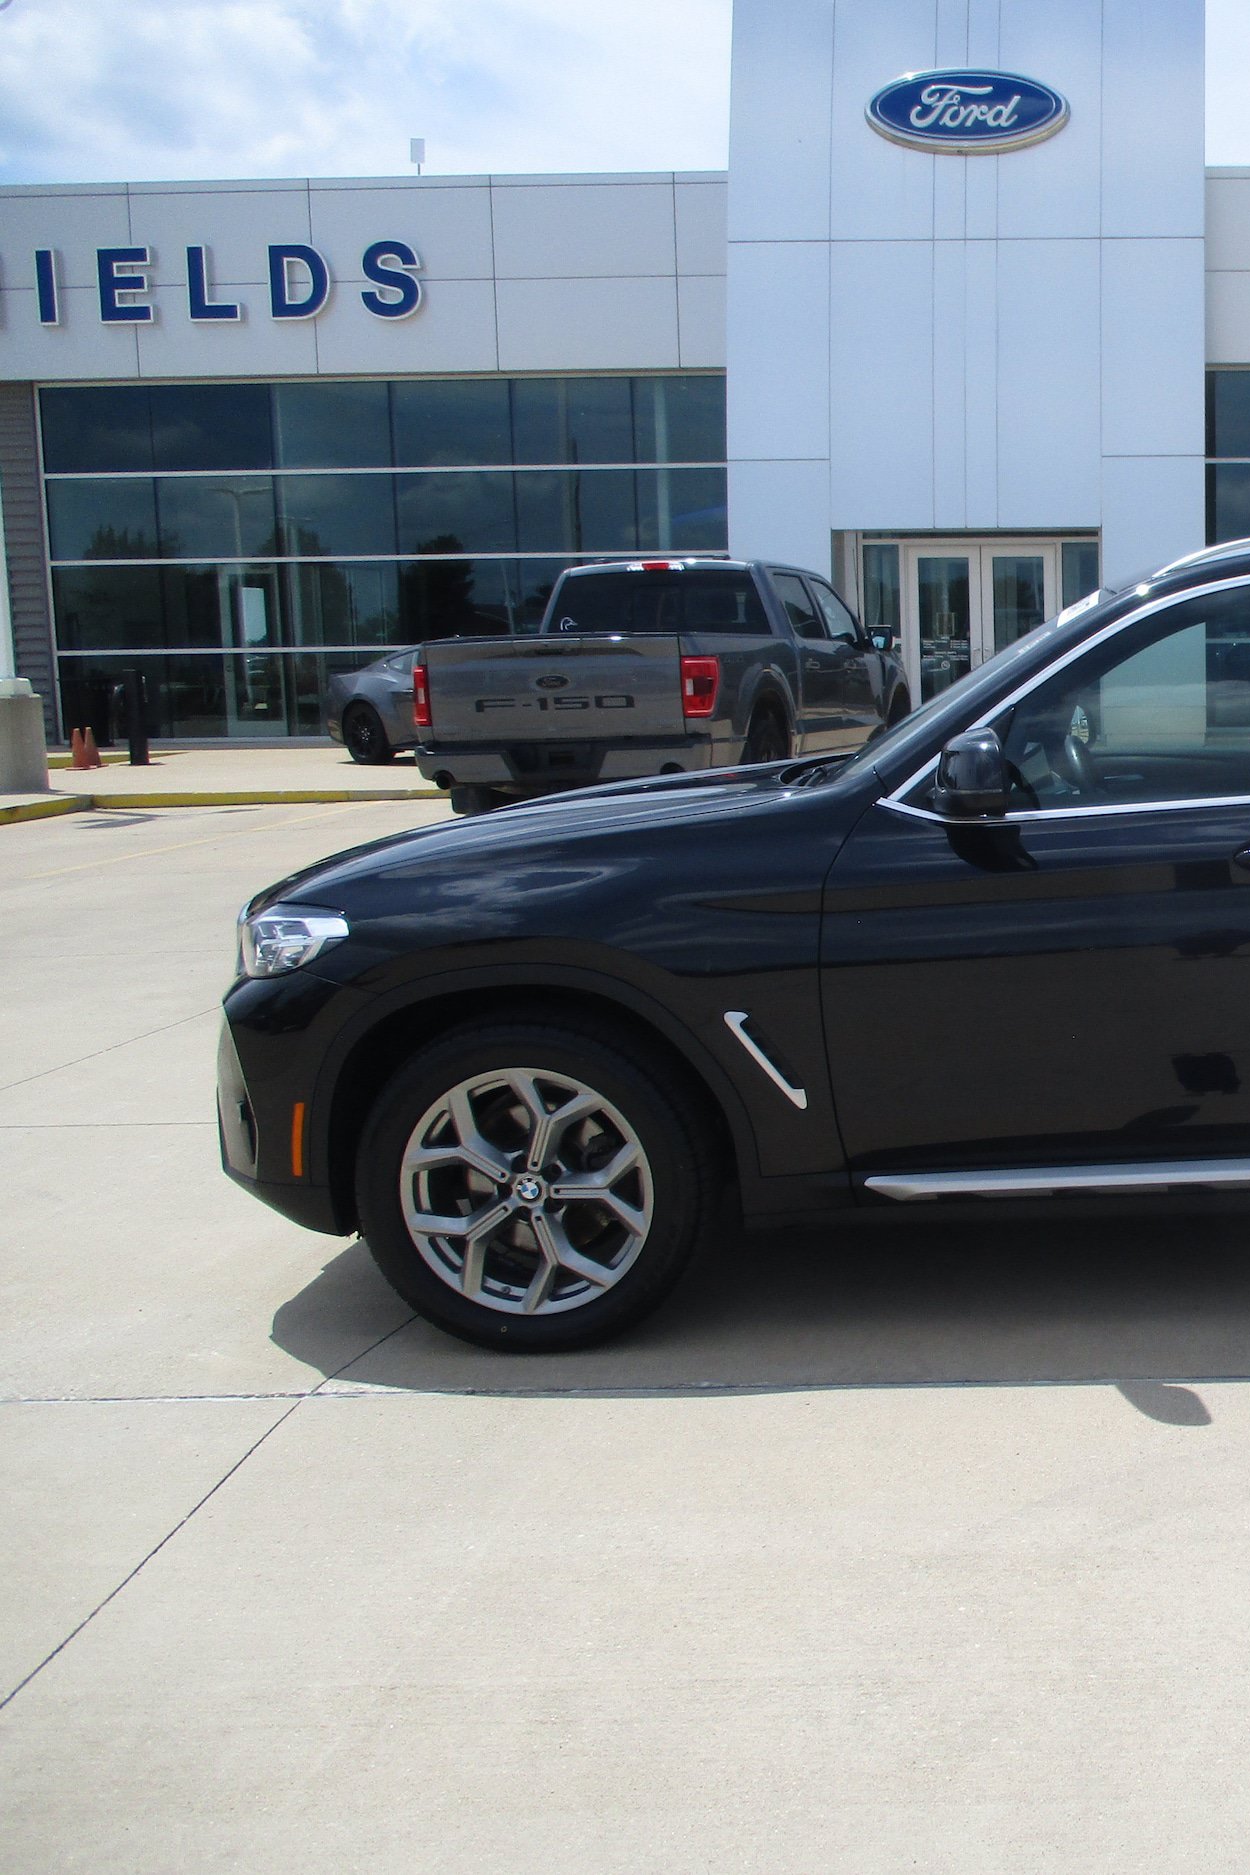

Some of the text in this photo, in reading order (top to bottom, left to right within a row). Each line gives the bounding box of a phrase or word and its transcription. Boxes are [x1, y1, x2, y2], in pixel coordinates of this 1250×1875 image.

[908, 83, 1022, 129] Ford
[35, 240, 423, 327] IELDS
[474, 694, 636, 713] F-150
